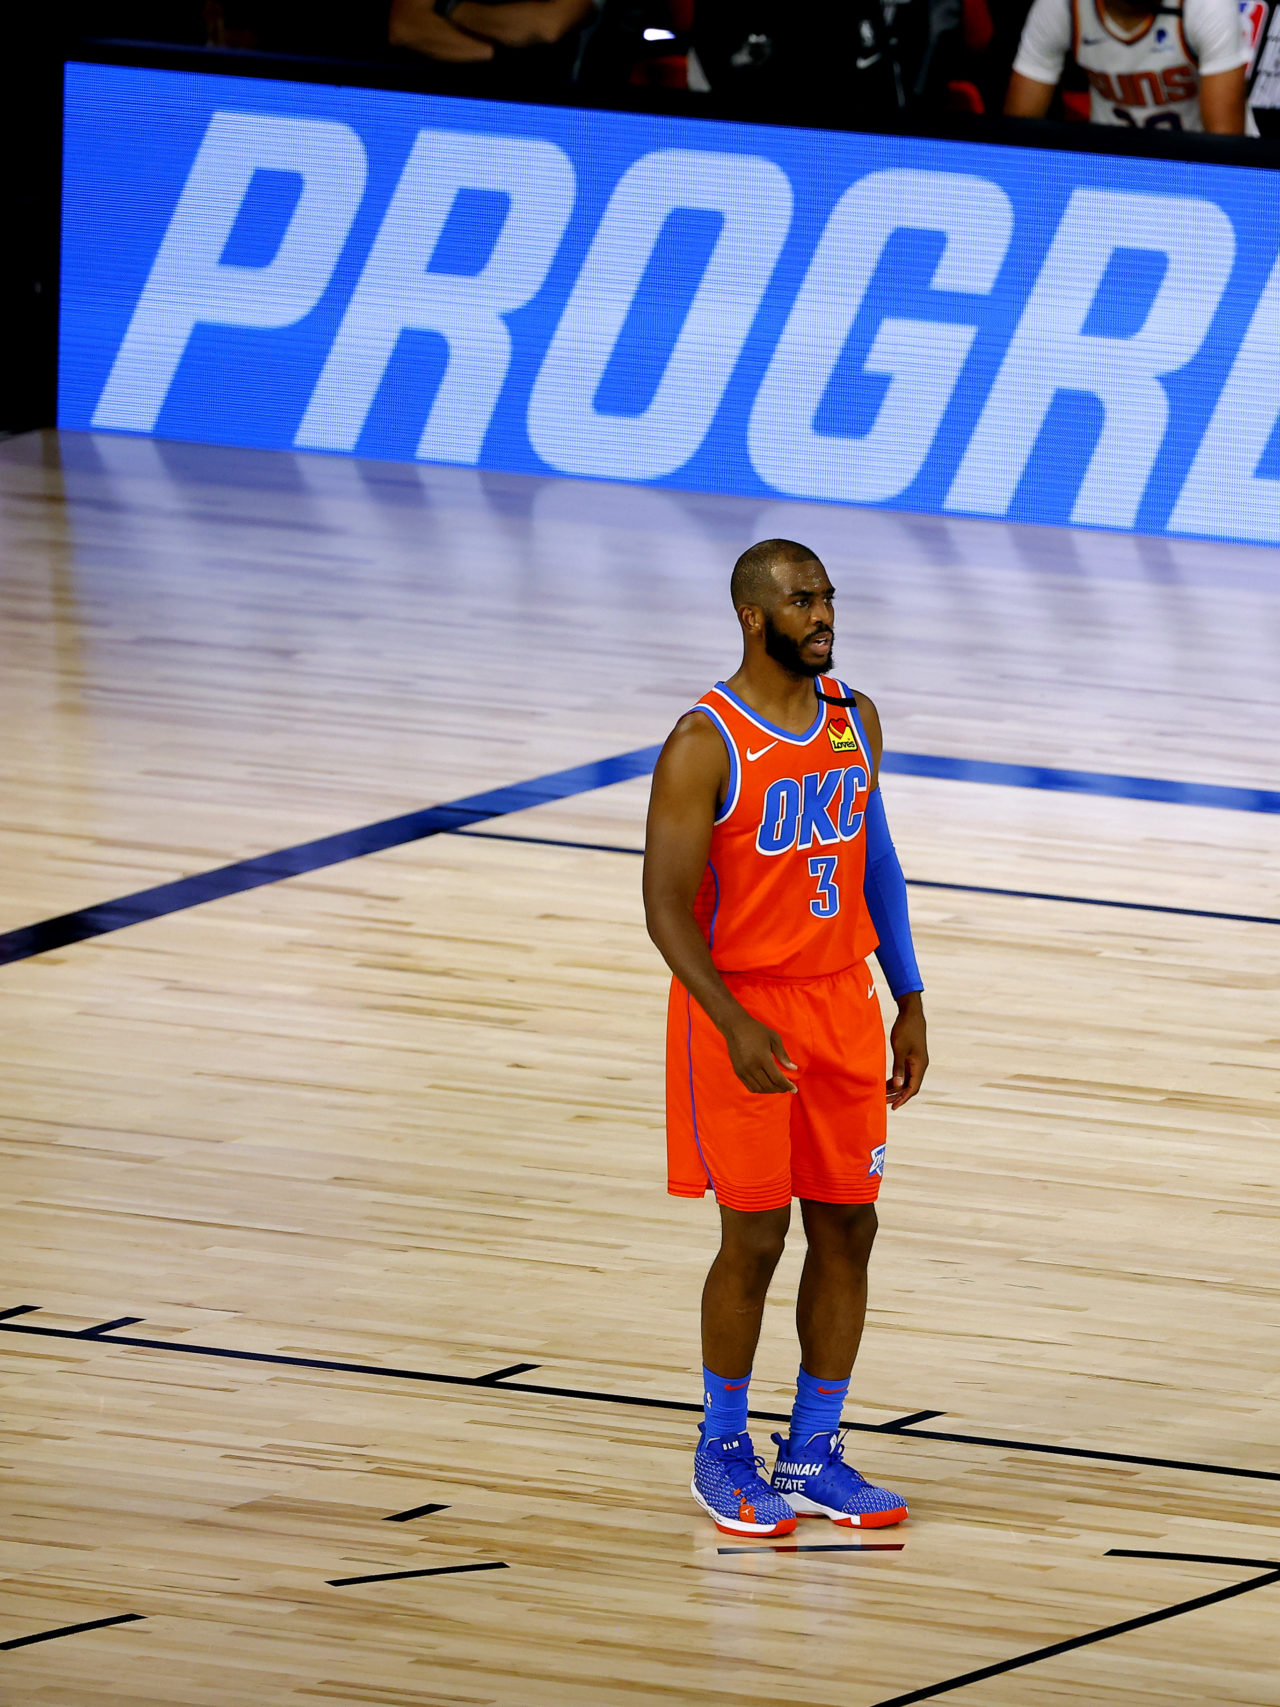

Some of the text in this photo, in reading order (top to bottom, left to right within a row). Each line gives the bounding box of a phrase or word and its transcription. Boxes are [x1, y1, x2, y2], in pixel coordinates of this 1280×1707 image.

[755, 765, 868, 856] OKC
[807, 855, 841, 918] 3
[722, 1440, 740, 1451] BLM
[773, 1477, 807, 1492] STATE
